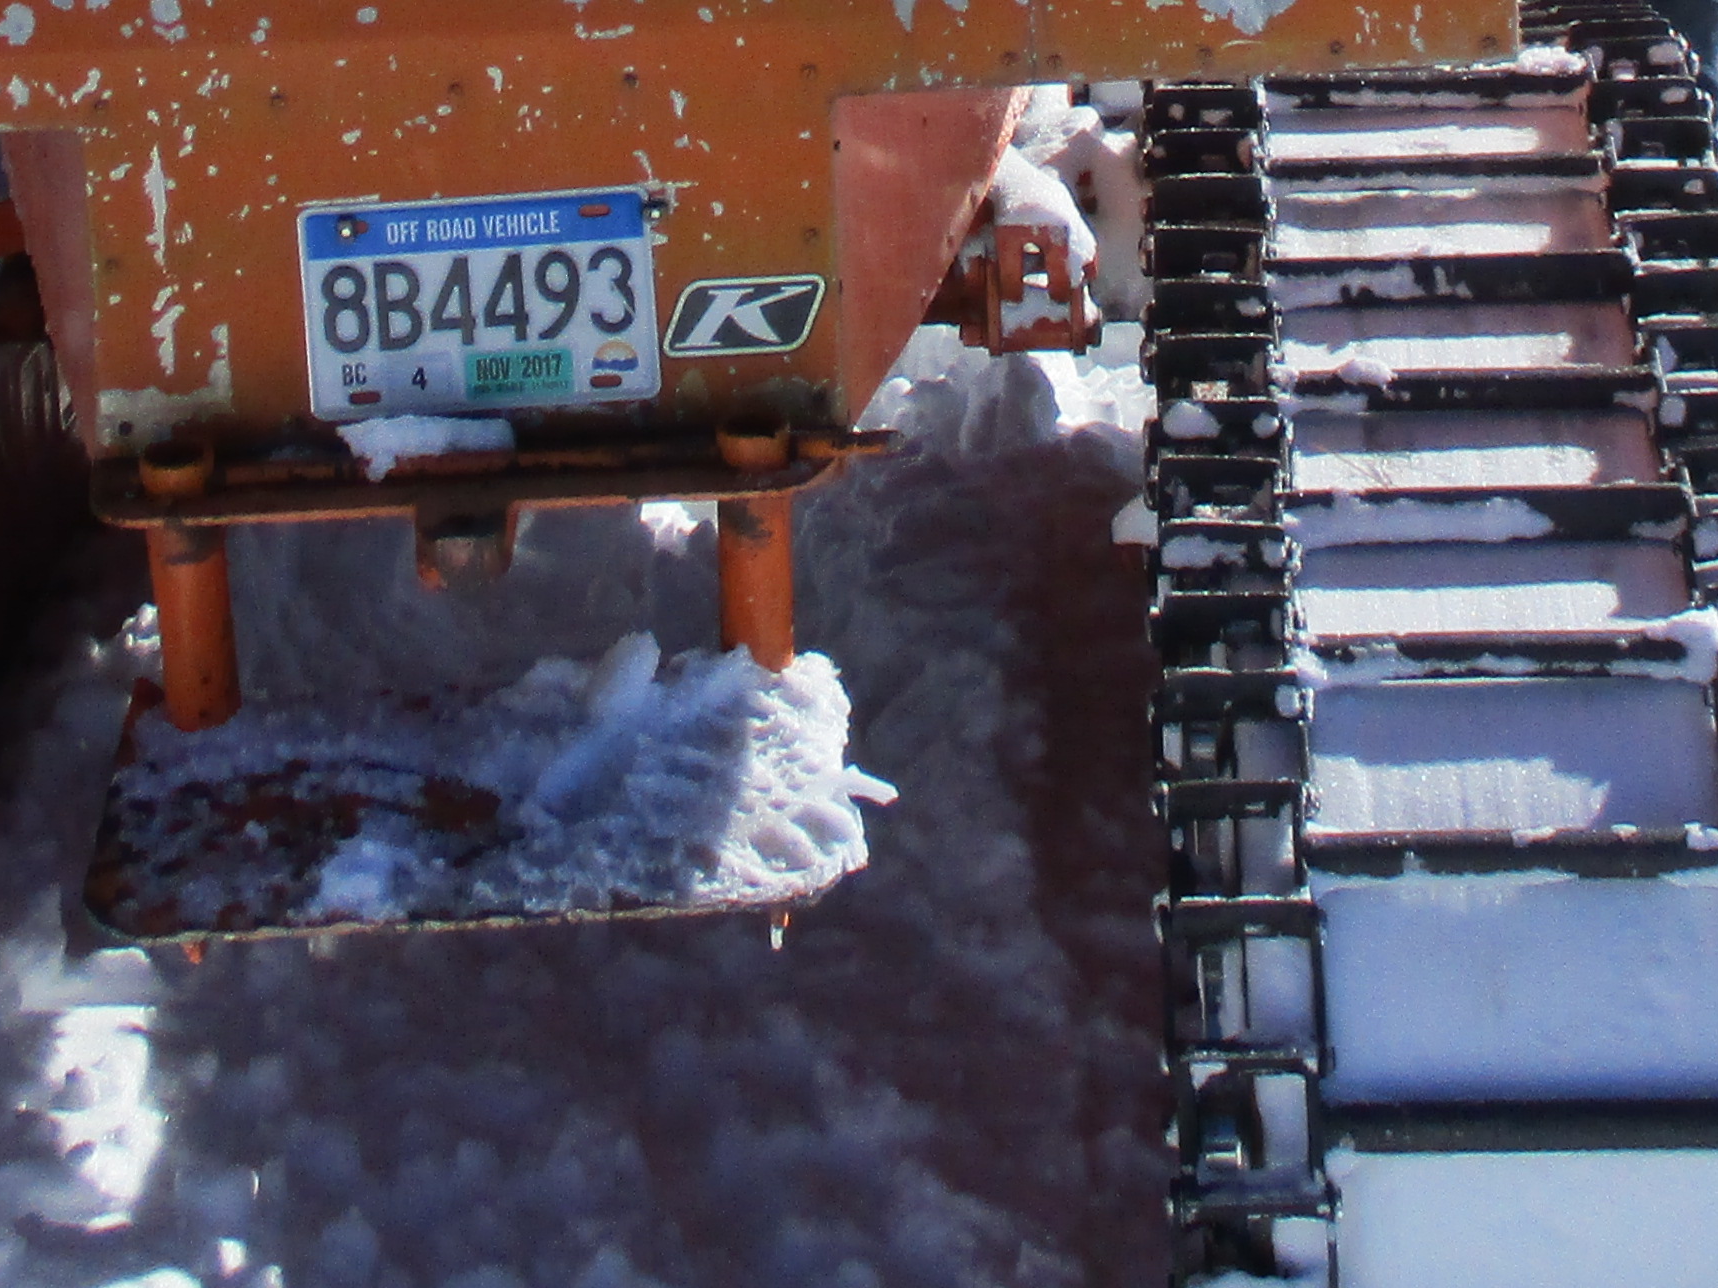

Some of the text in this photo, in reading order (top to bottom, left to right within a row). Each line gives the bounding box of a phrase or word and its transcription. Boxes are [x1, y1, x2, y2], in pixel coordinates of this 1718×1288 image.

[386, 210, 560, 245] OFF ROAD VEHICLE
[320, 245, 637, 354] 8B4493
[673, 283, 813, 349] K
[341, 362, 367, 386] BC
[411, 366, 428, 391] 4
[475, 353, 562, 381] NOV 2017
